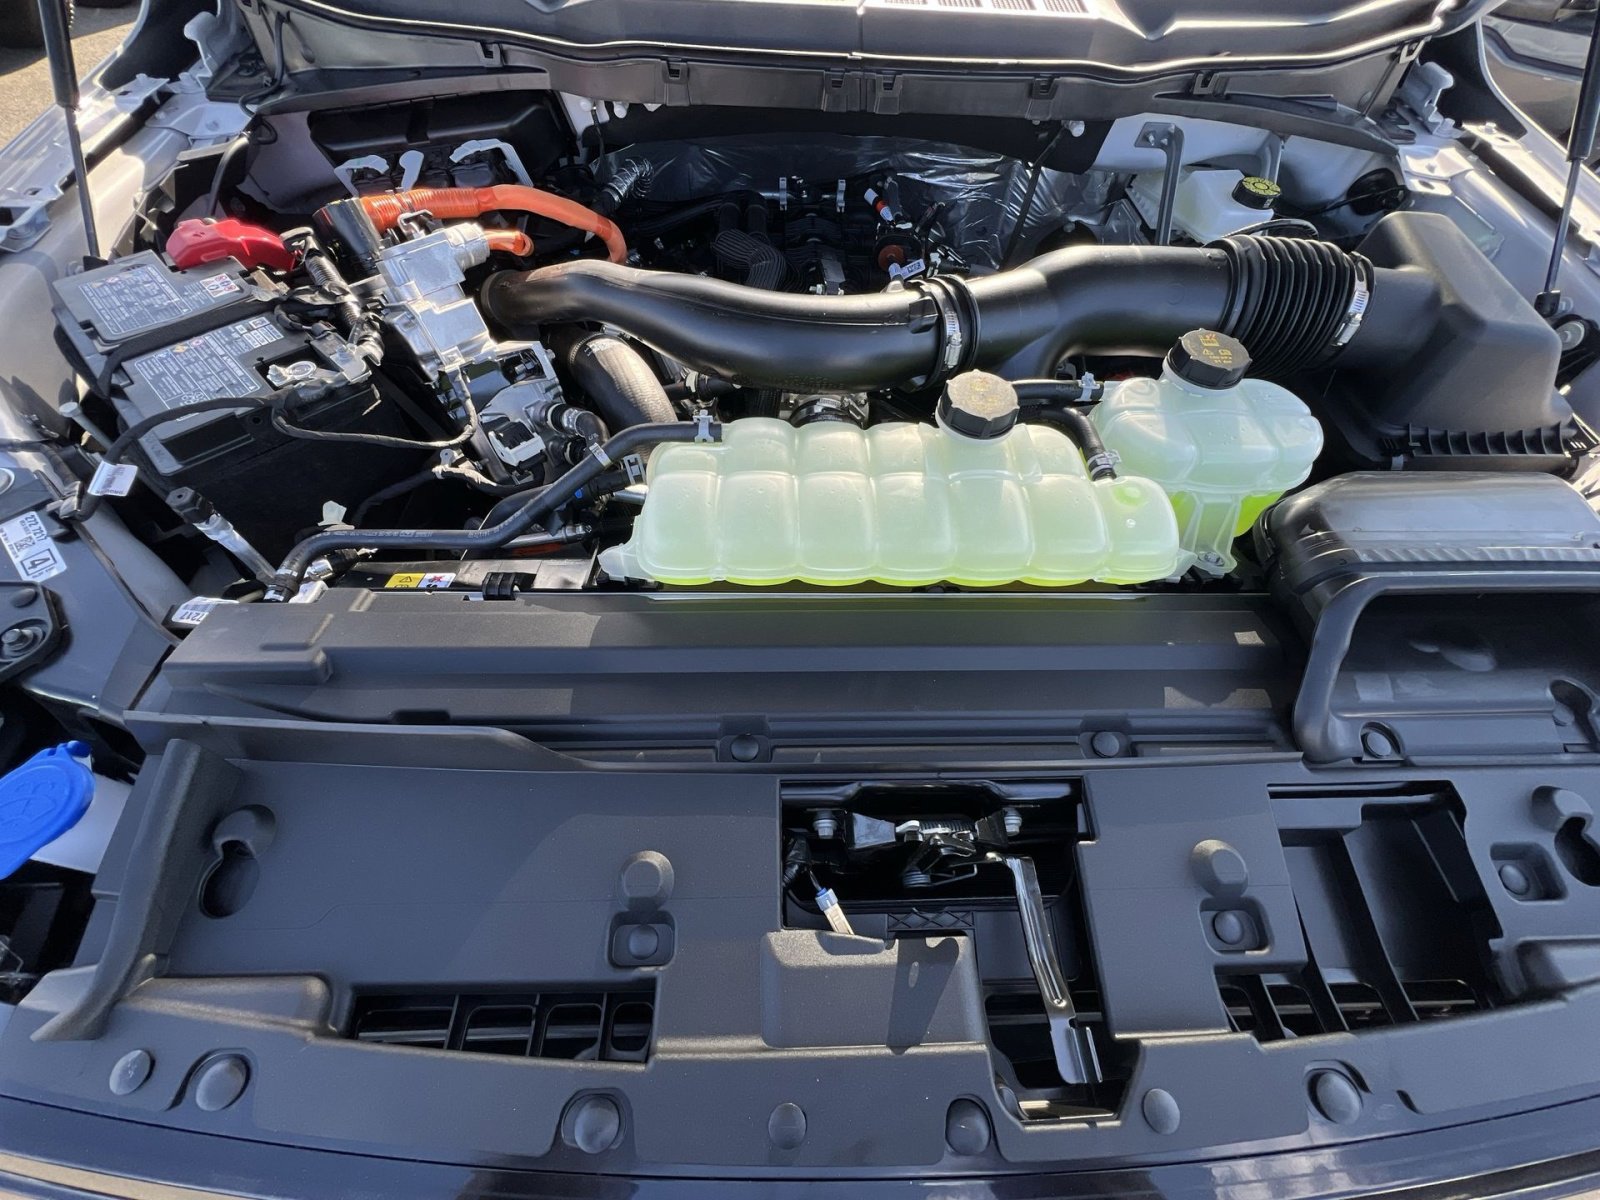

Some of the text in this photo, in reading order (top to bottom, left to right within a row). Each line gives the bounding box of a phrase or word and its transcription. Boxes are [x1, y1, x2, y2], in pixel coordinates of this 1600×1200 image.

[25, 514, 39, 527] 272
[27, 557, 51, 570] 4
[179, 611, 205, 622] 7217
